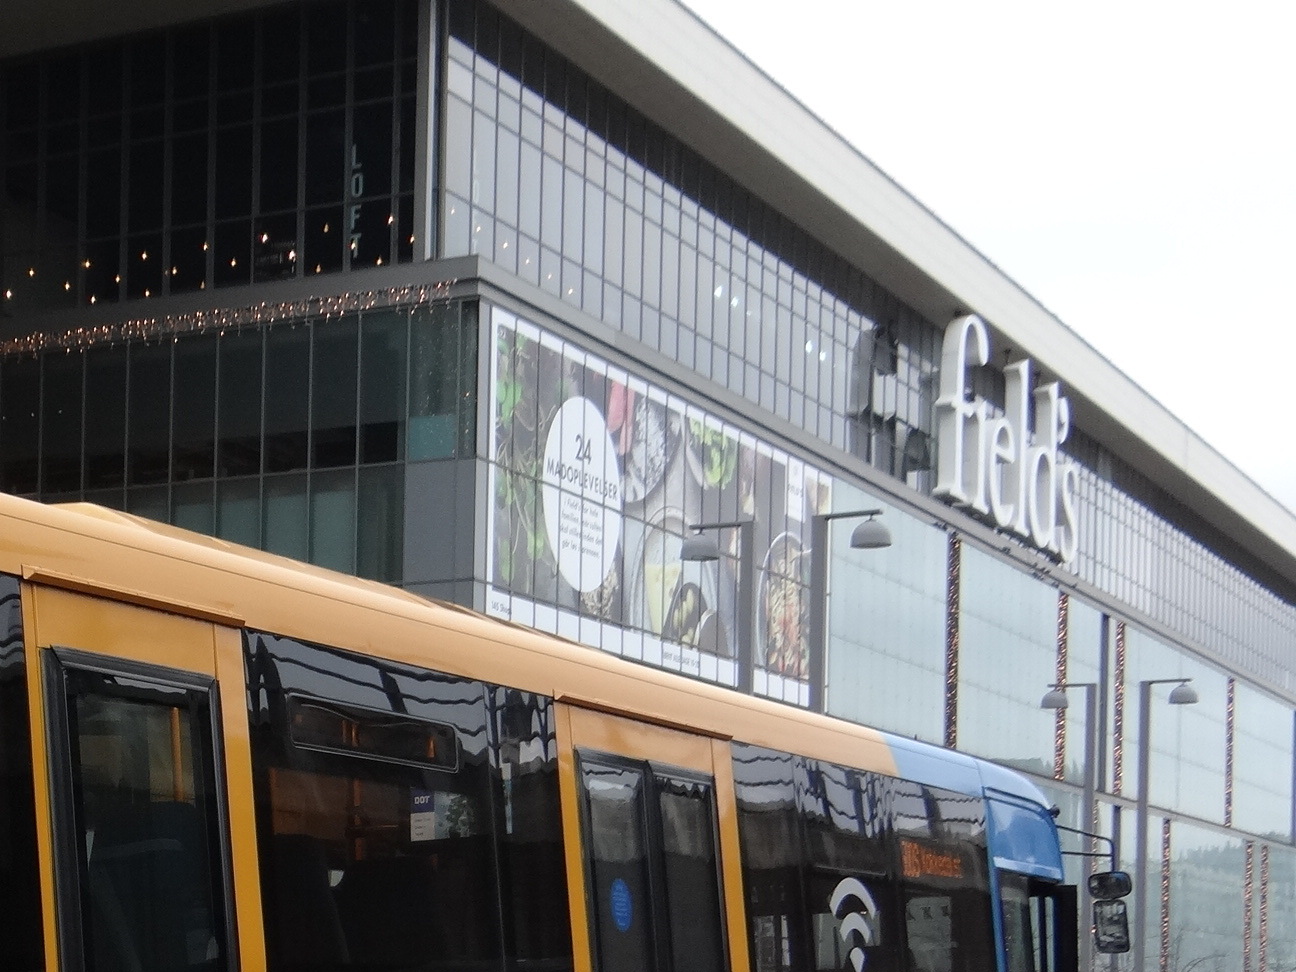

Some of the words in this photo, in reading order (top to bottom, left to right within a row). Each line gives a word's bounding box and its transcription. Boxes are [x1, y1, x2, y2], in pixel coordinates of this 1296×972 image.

[574, 434, 593, 465] 24
[932, 314, 1079, 563] field's
[546, 456, 618, 501] MADOPLEVELSER
